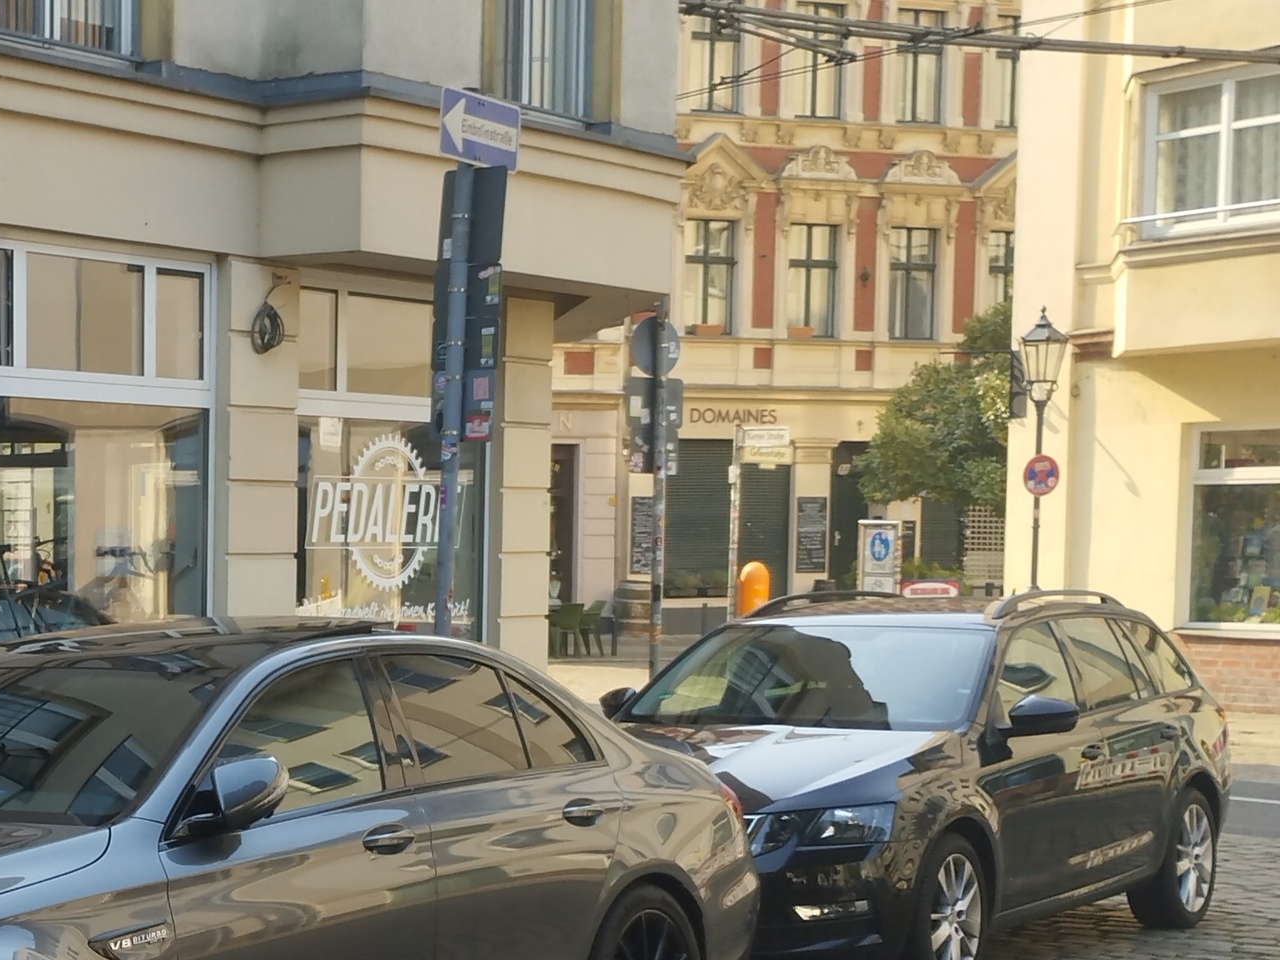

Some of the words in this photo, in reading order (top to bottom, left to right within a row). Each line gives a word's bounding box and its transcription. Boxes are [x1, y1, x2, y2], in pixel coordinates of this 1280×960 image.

[690, 408, 778, 424] DOMAINES
[312, 482, 461, 542] PEDALERI
[110, 938, 131, 950] V8
